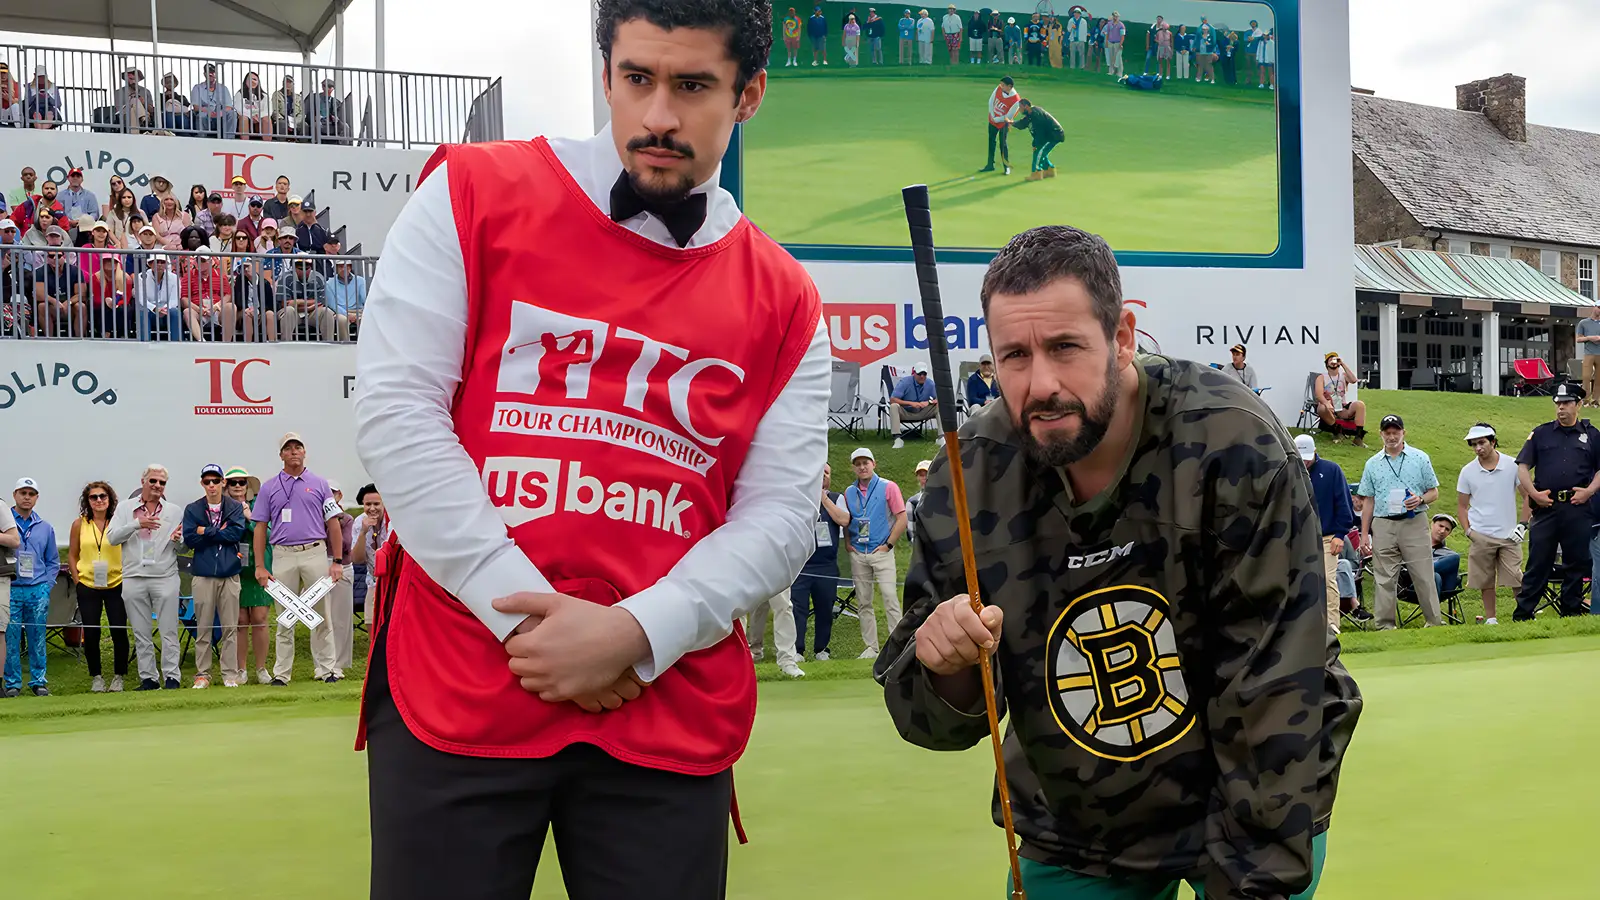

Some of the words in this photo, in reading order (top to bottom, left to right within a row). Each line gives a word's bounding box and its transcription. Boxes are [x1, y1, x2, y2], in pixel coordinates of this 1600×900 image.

[213, 152, 274, 190] TC
[332, 170, 410, 193] RIVI
[830, 314, 890, 351] us
[904, 303, 986, 350] ban
[1196, 325, 1320, 345] RIVIAN
[194, 358, 272, 404] TC
[615, 326, 746, 447] TC
[498, 409, 552, 431] TOUR
[558, 414, 707, 468] CHAMPIONSHIP
[487, 470, 549, 509] us
[564, 461, 693, 537] bank
[1067, 541, 1135, 569] CCM
[286, 587, 322, 620] QIET
[1078, 623, 1165, 725] B
